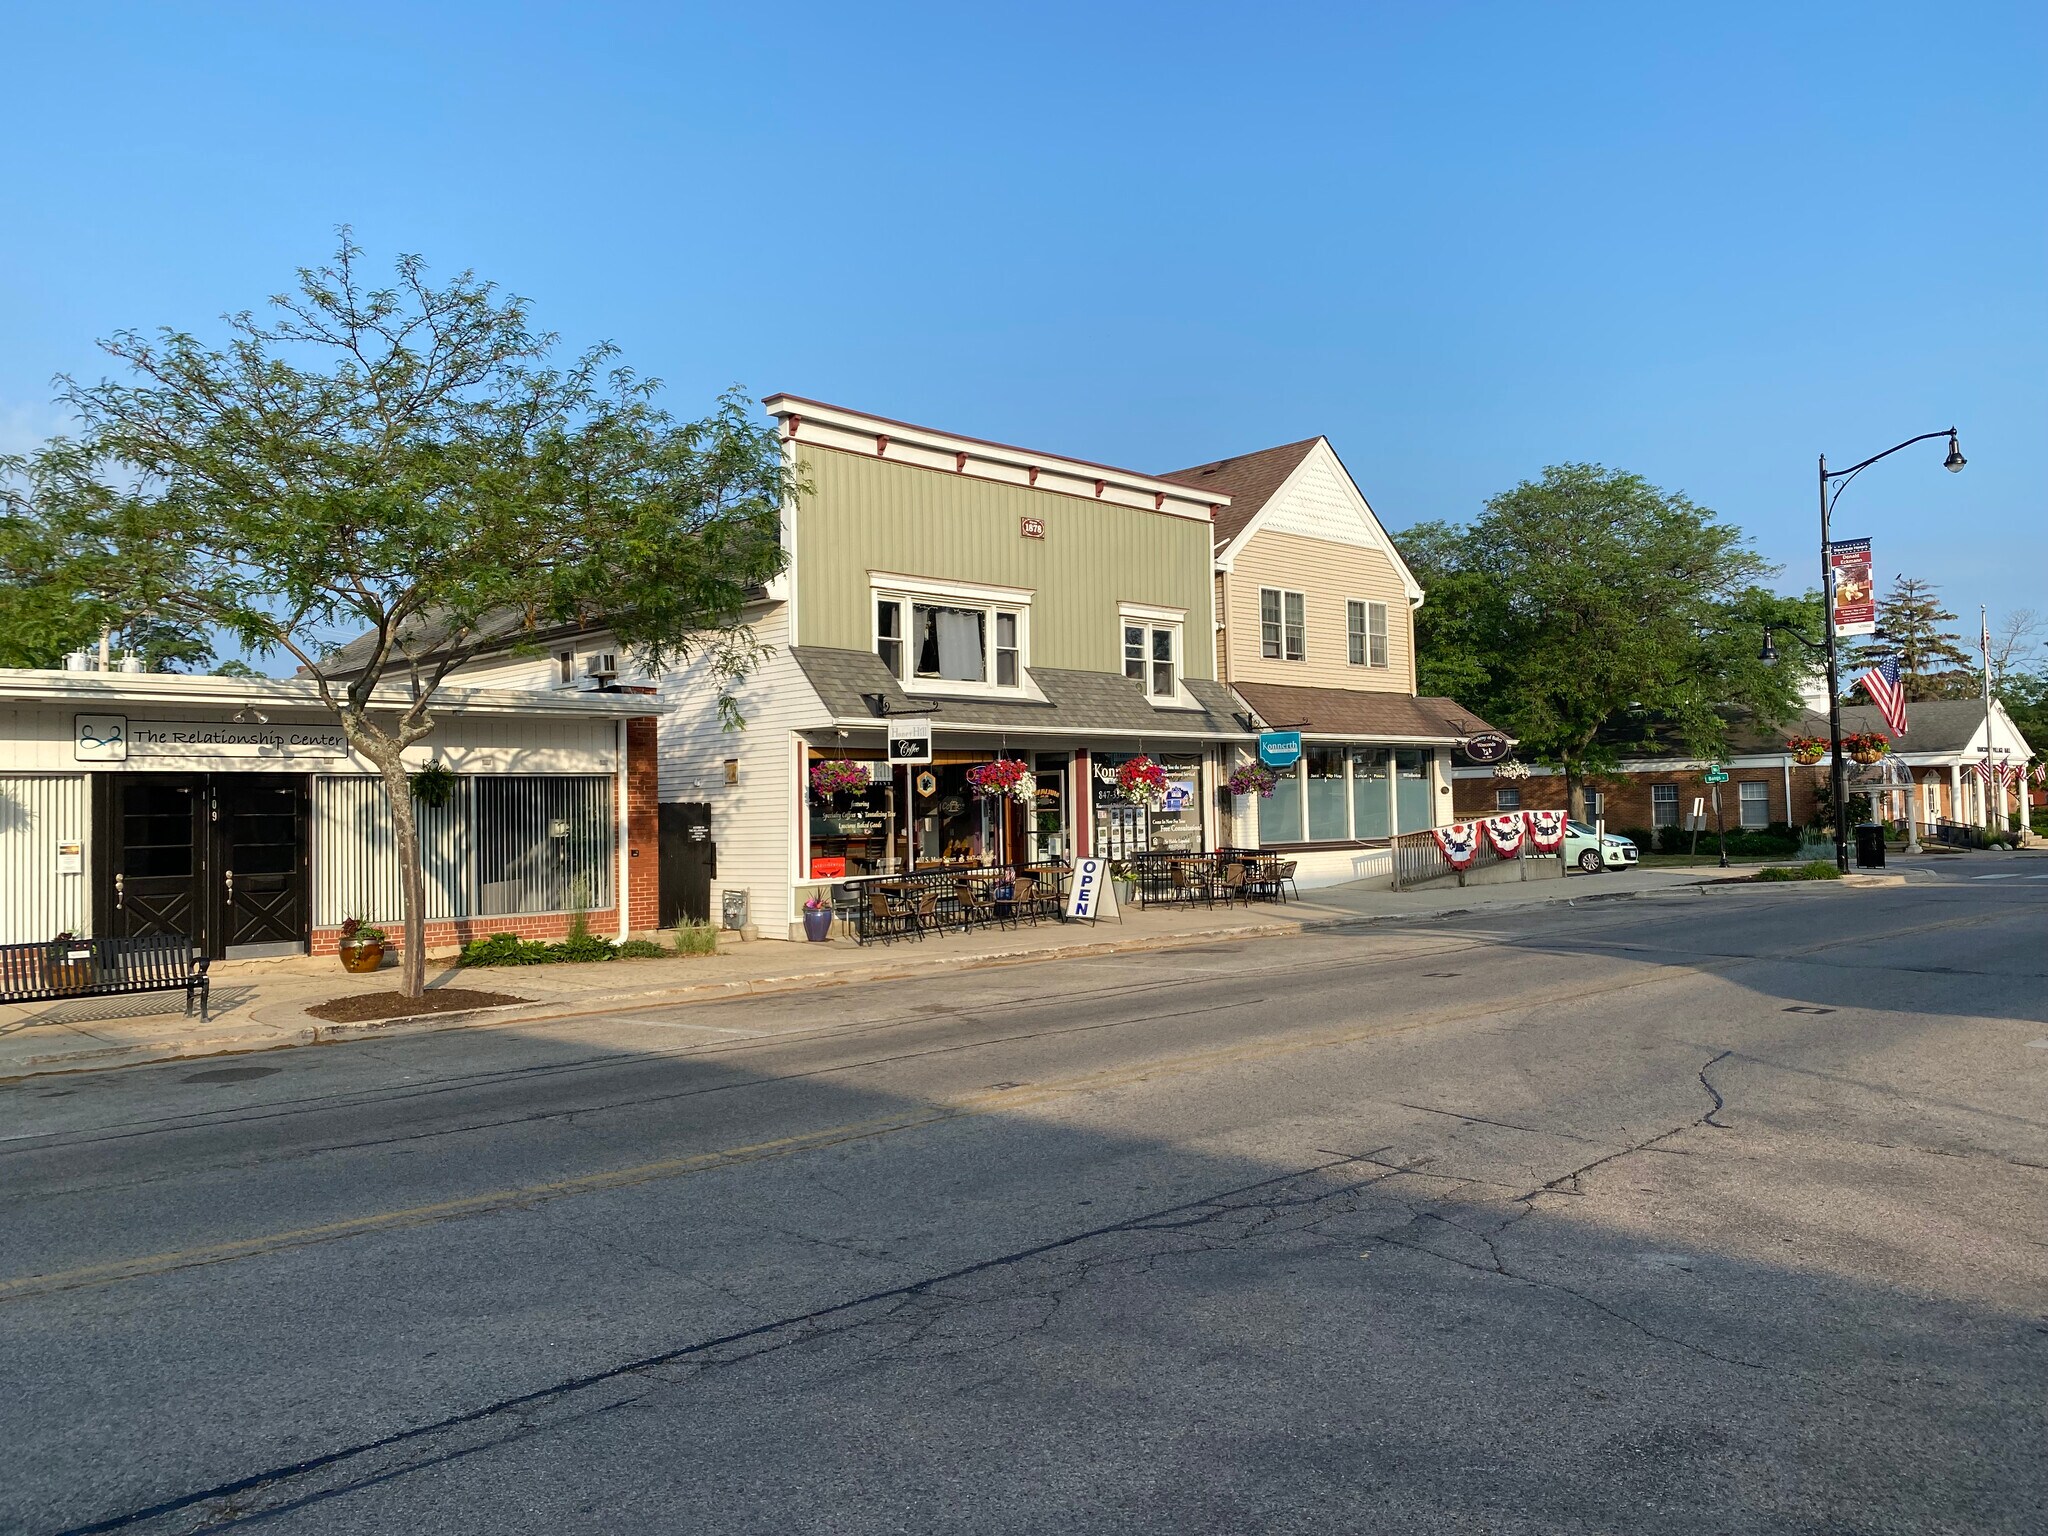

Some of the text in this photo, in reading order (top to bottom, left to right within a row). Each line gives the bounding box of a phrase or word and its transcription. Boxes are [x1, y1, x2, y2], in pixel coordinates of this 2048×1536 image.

[134, 729, 343, 751] The Relationship Center
[913, 726, 928, 737] Hill
[898, 740, 920, 757] Coffee
[1262, 740, 1298, 751] Konnerth
[1075, 861, 1096, 915] OPEN
